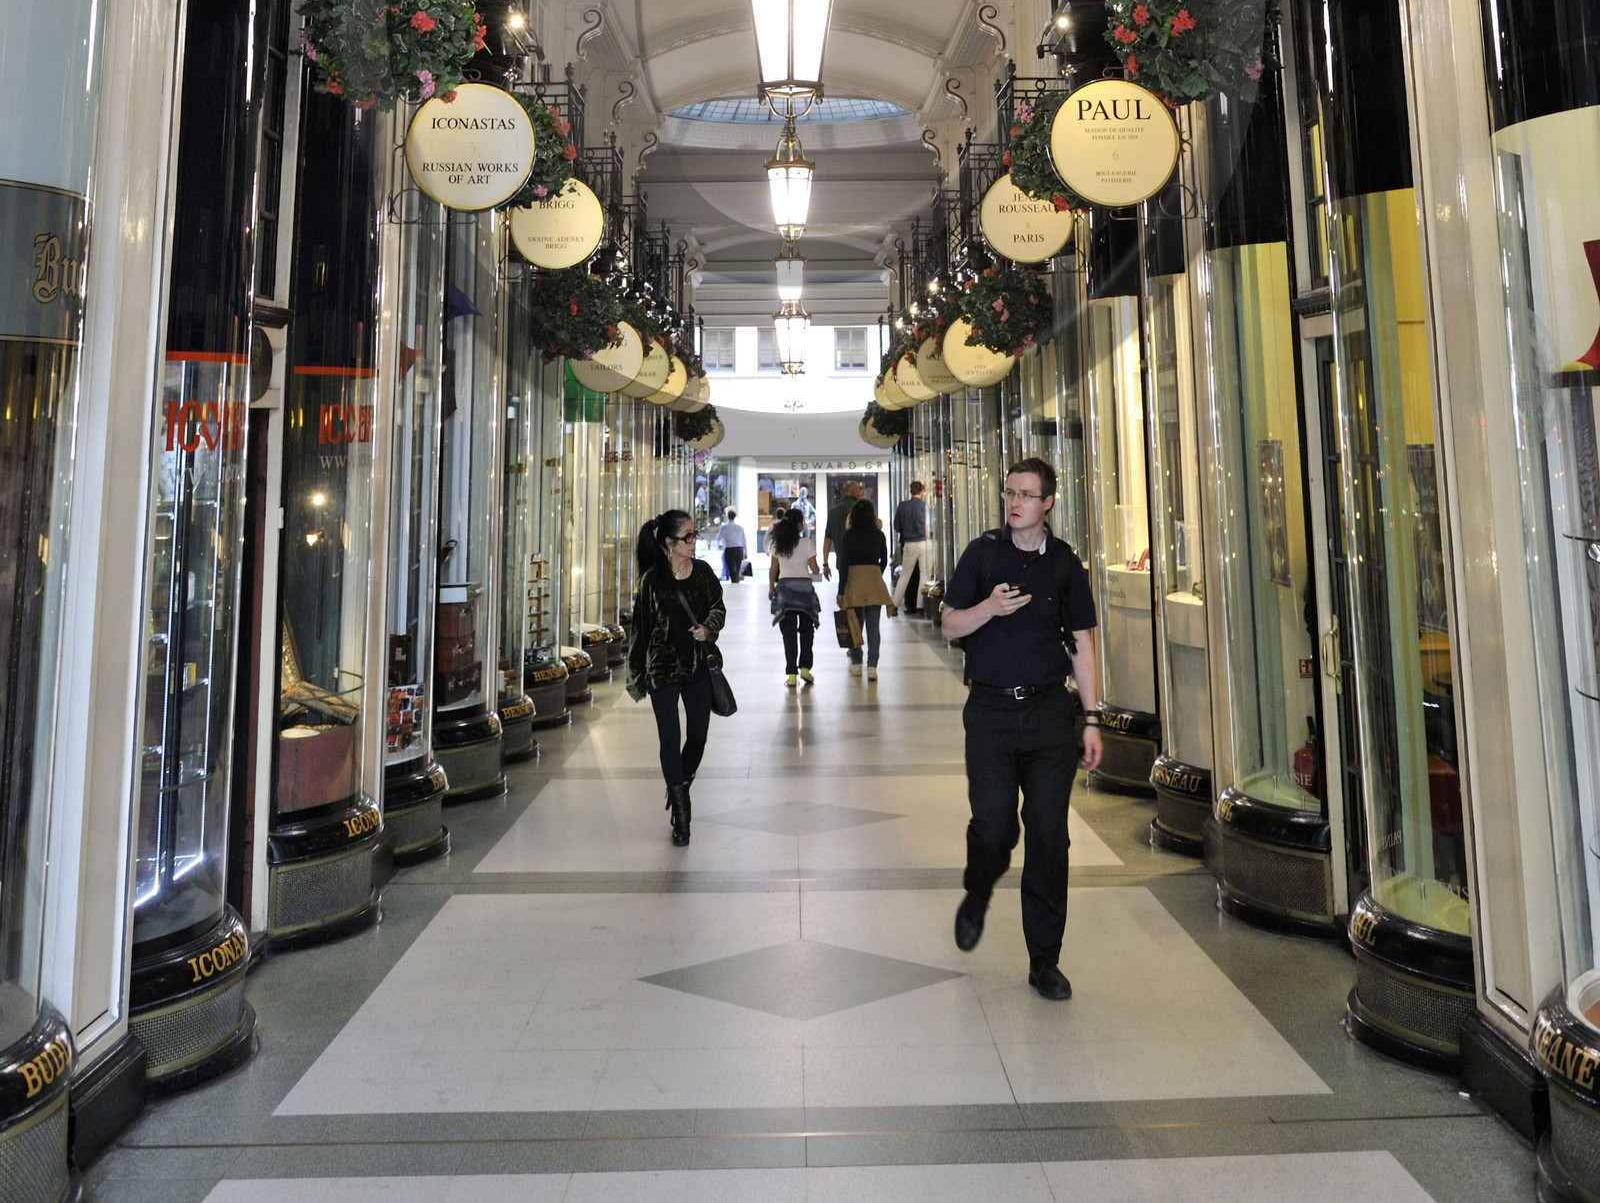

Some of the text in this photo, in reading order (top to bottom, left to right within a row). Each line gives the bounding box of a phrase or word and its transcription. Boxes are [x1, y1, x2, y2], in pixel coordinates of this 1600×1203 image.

[1076, 99, 1152, 121] PAUL
[431, 117, 516, 130] ICONASTAS
[1112, 149, 1120, 160] 6
[422, 162, 519, 173] RUSSIAN WORKS
[448, 174, 492, 184] OF ART
[539, 199, 575, 210] BRIGG
[1013, 233, 1045, 244] PARIS
[589, 363, 624, 372] TAILORS
[791, 460, 857, 471] EDWARD
